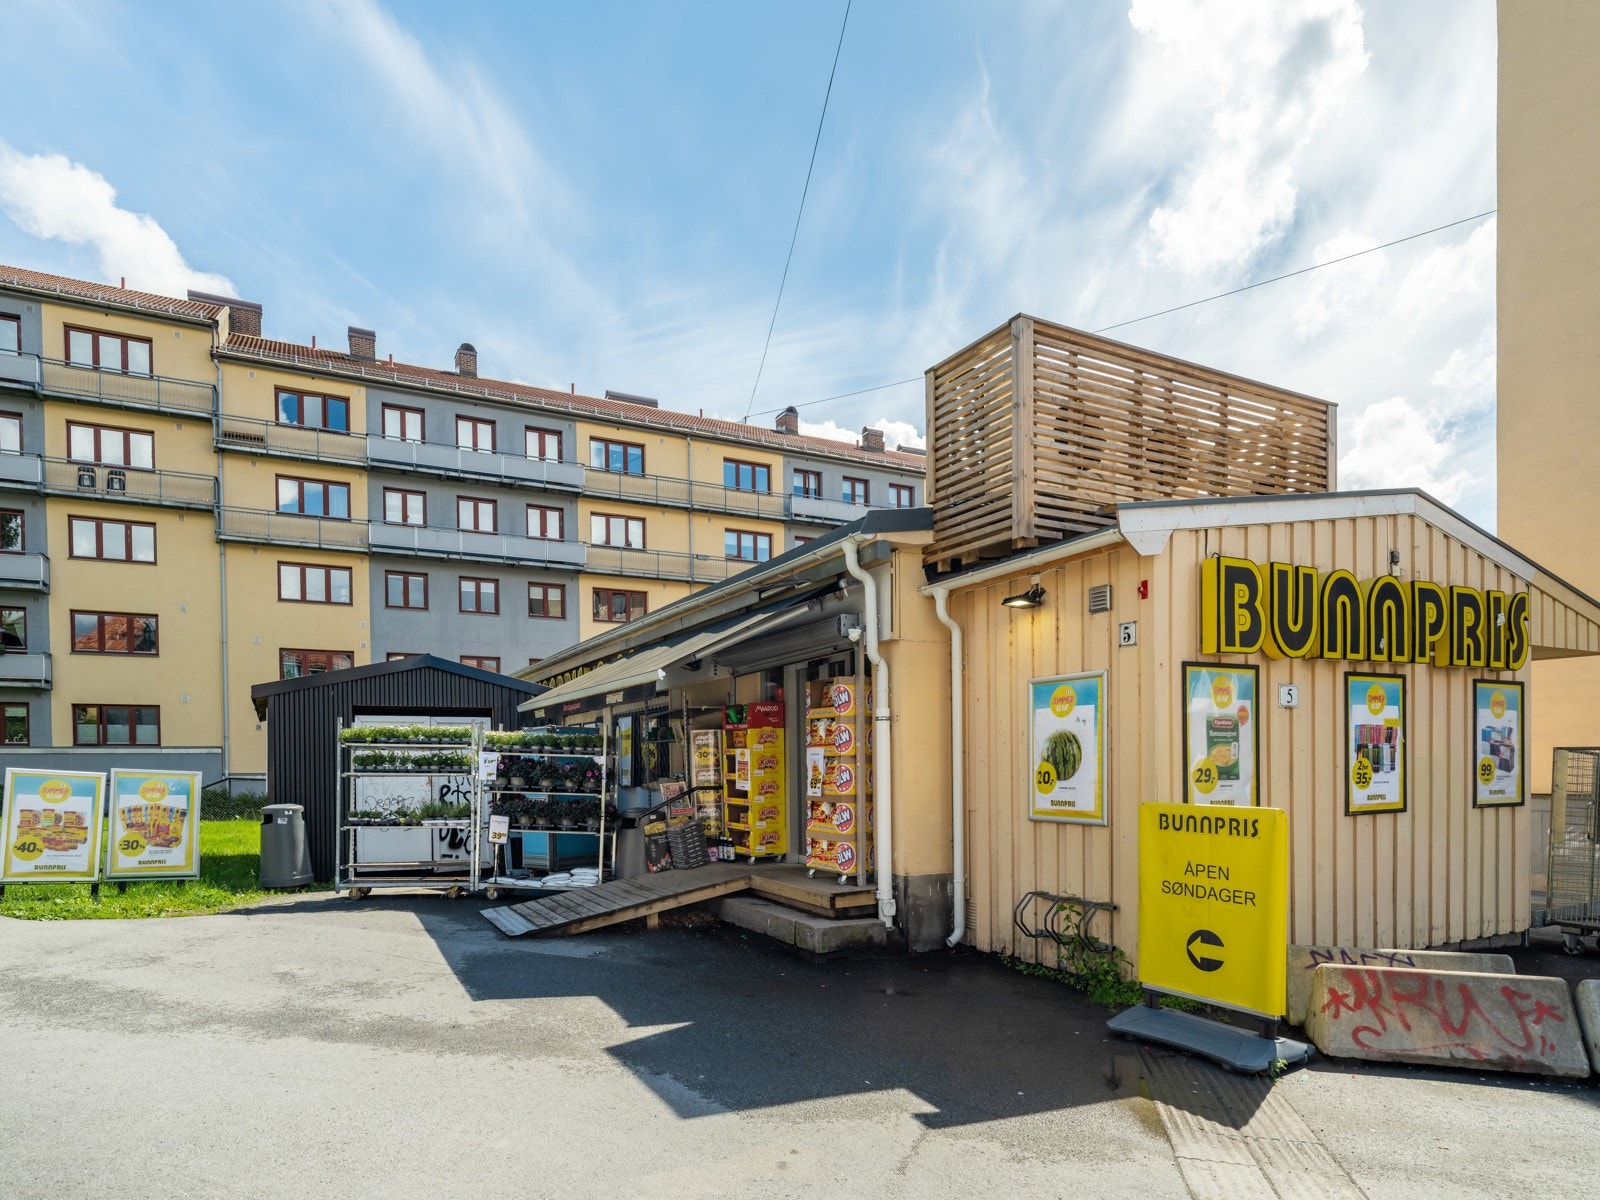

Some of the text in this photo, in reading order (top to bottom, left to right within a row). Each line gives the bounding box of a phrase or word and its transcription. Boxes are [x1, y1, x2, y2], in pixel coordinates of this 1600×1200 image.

[1204, 556, 1529, 671] BUNNPRIS
[1123, 625, 1132, 643] 5
[834, 691, 849, 708] OLW
[1286, 688, 1293, 704] 5
[835, 730, 850, 747] OLW
[836, 770, 851, 786] OLW
[1050, 799, 1076, 807] BUNNPRIS
[835, 809, 851, 825] OLW
[1158, 813, 1260, 838] BUNNPRIS
[837, 848, 853, 864] OLW
[1183, 861, 1230, 881] ÅPEN
[1161, 880, 1257, 907] SØNDAGER
